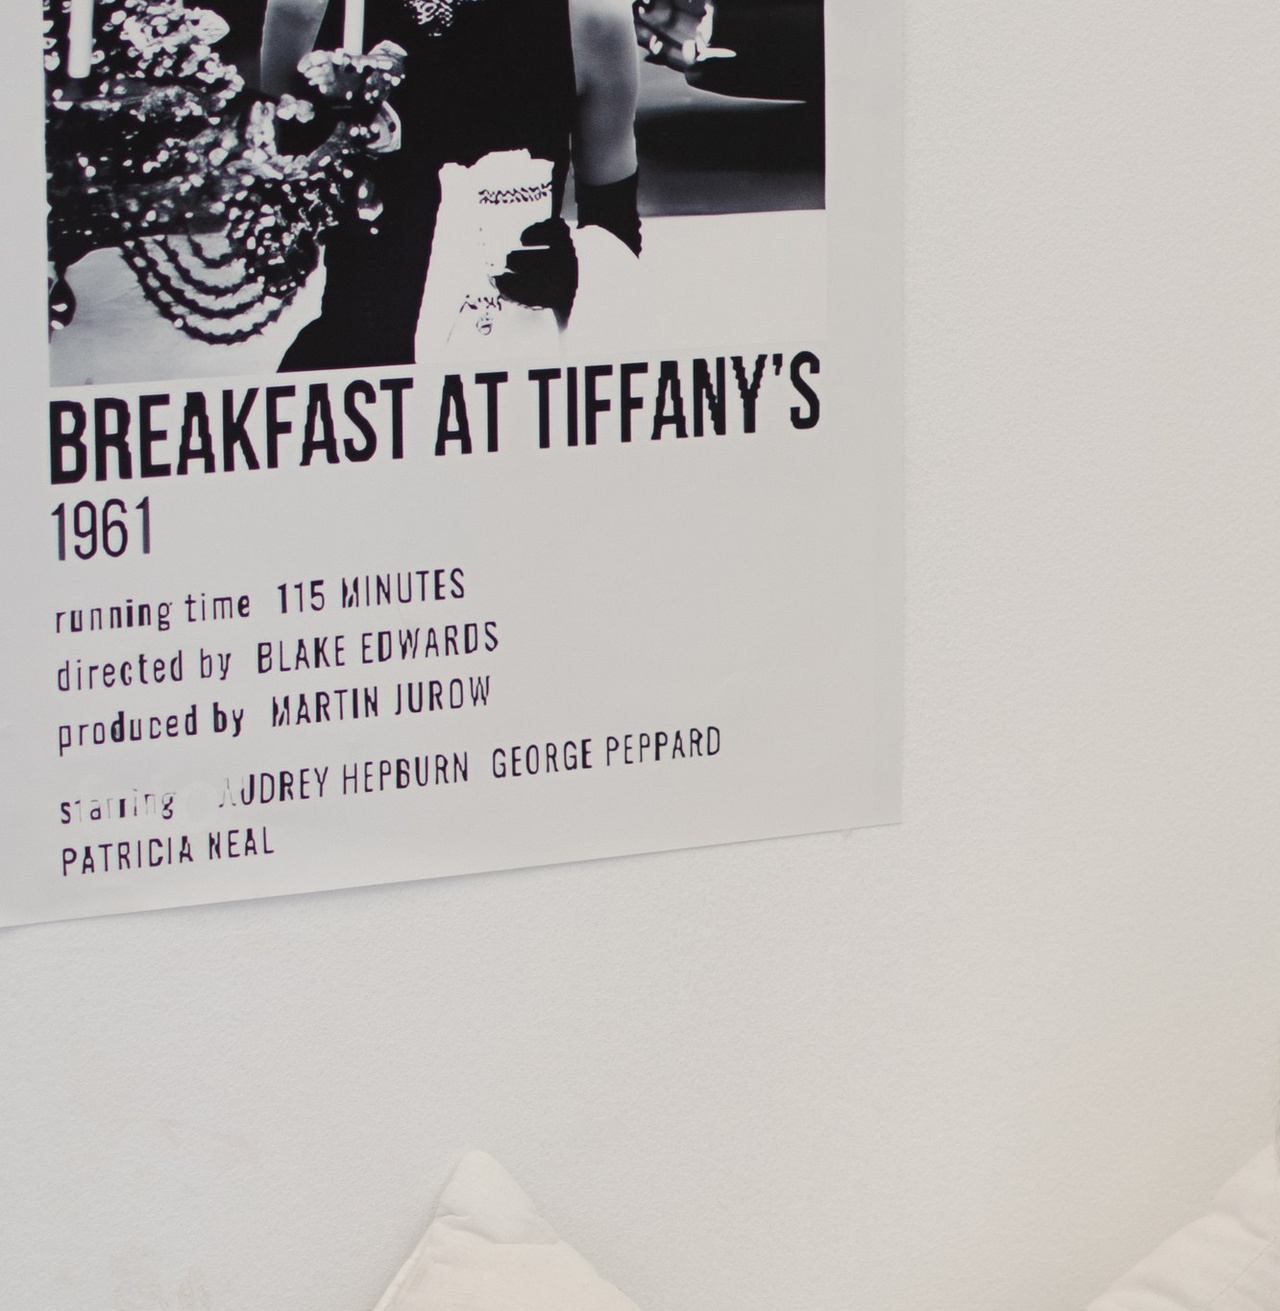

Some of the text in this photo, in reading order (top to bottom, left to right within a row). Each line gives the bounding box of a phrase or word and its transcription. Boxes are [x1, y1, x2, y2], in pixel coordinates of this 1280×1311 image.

[48, 350, 821, 486] BREAKFAST AT TIFFANY'S
[50, 495, 151, 562] 1961
[55, 567, 466, 634] running time 115 MINUTES
[57, 620, 499, 692] directed by BLAKE EDWARDS
[58, 674, 492, 757] produced by MARTIN JUROW
[342, 750, 469, 796] HEPBURN
[492, 737, 593, 779] GEORGE
[605, 725, 721, 767] PEPPARD
[61, 825, 275, 876] PATRICIA NEAL
